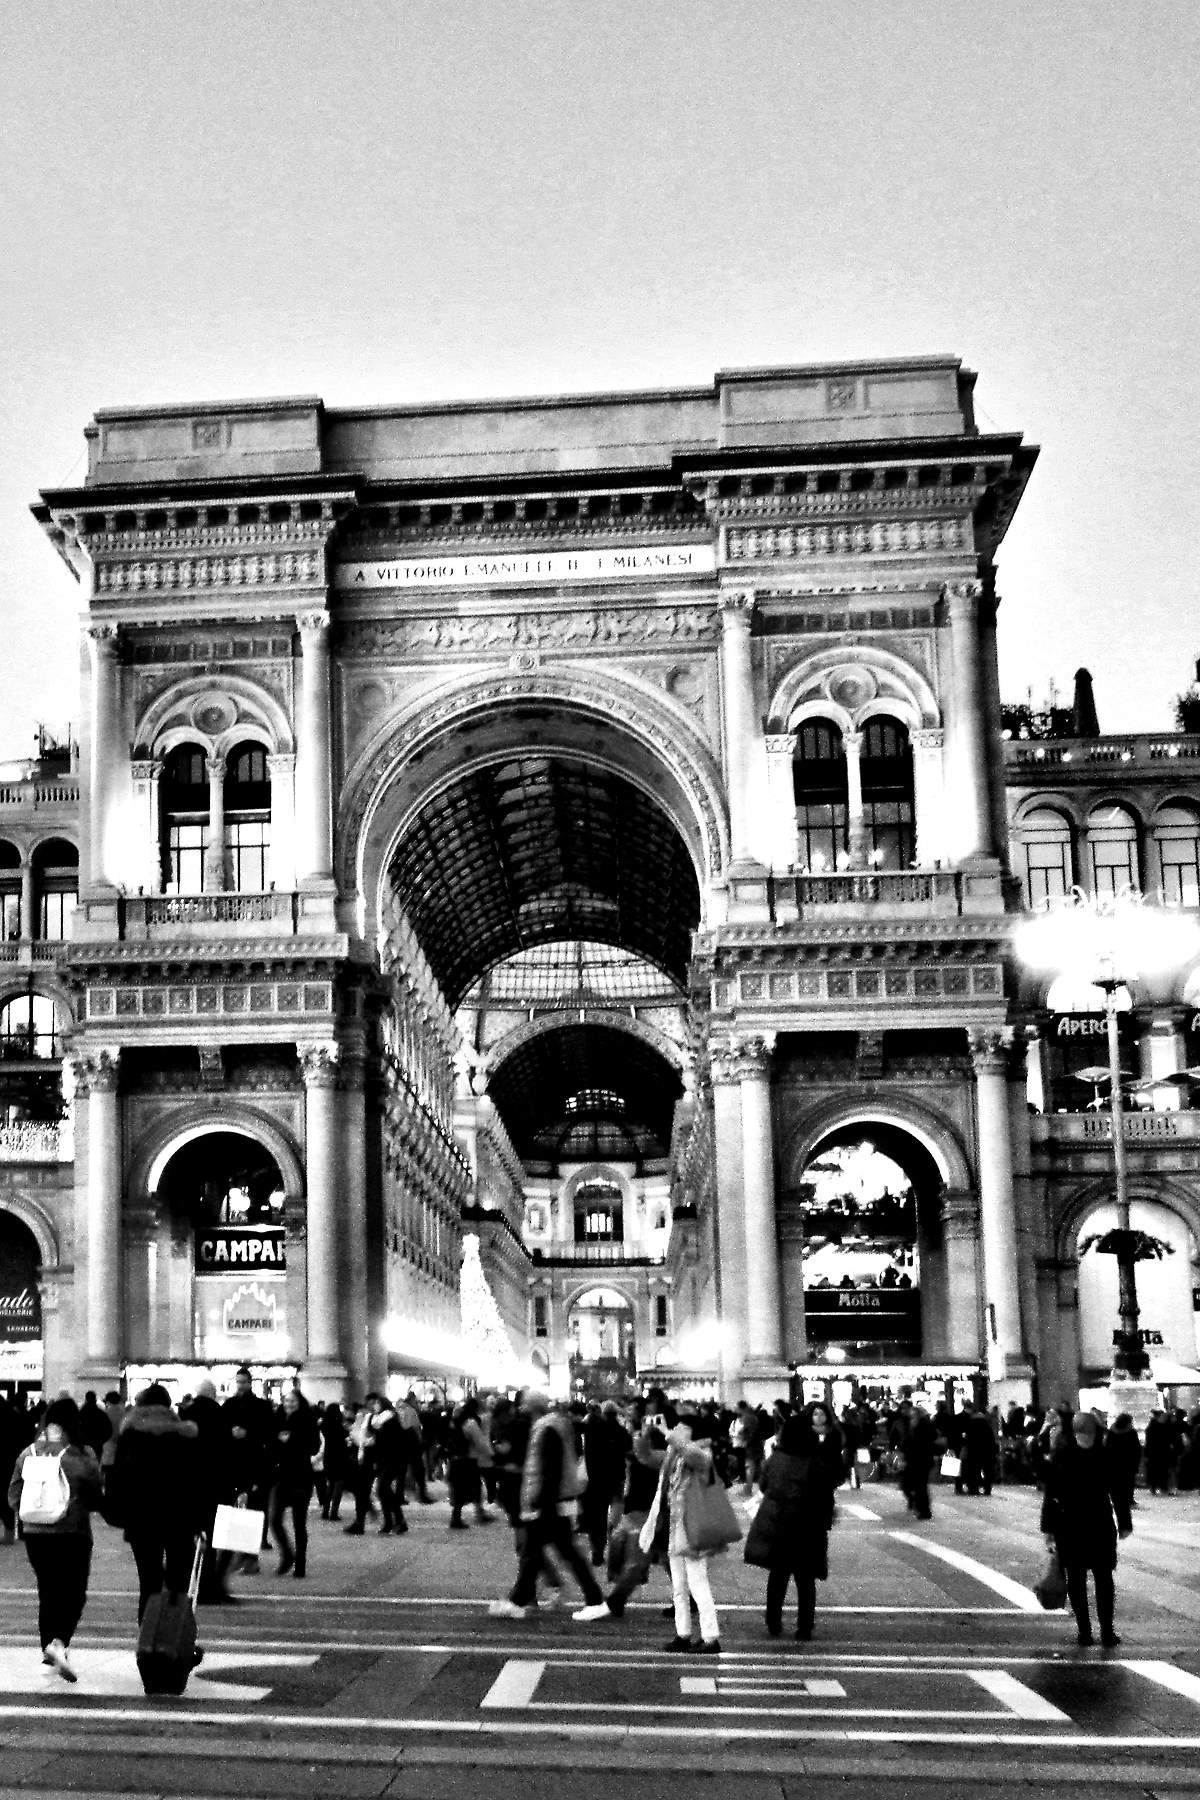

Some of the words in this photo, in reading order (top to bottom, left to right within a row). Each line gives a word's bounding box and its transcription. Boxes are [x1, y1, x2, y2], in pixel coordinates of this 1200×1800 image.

[355, 570, 365, 582] A
[377, 565, 453, 580] VITTORIO
[613, 553, 692, 568] MILANESI
[1057, 1016, 1122, 1036] APERO
[838, 1292, 881, 1307] Motta
[228, 1319, 272, 1329] CAMPARI
[1112, 1329, 1163, 1345] Mtta
